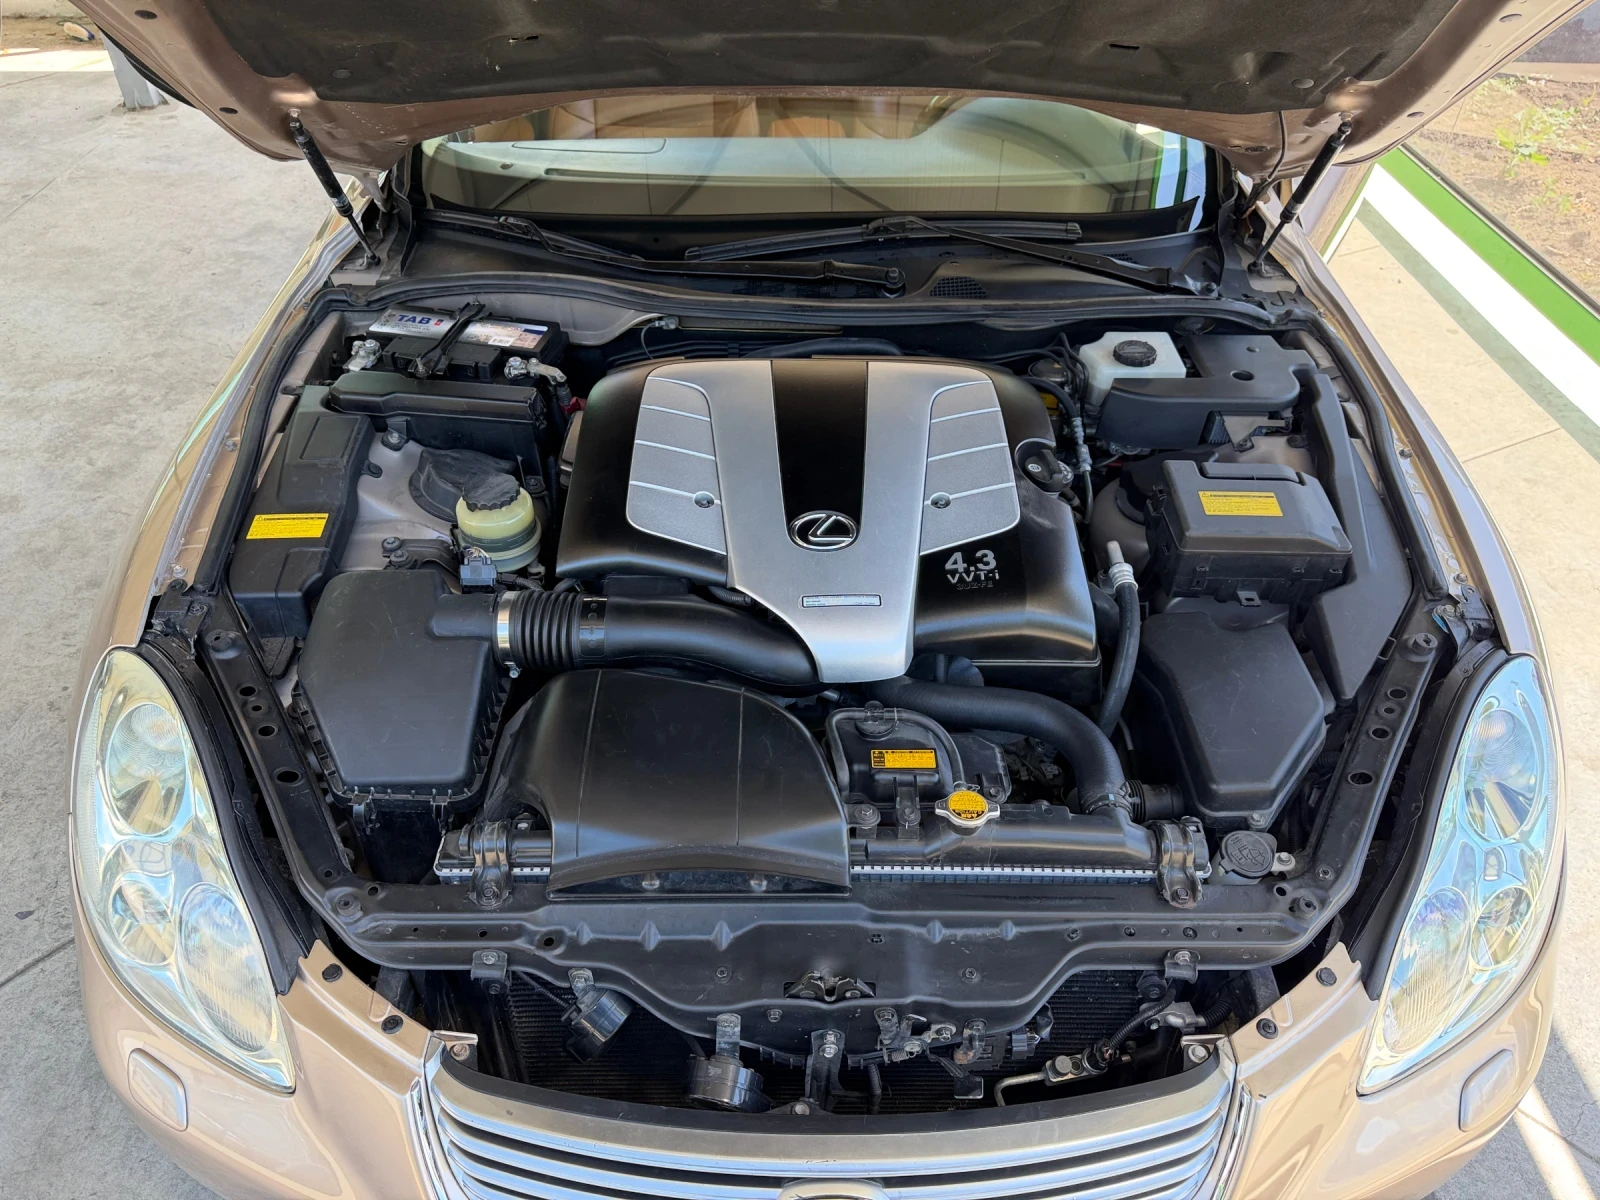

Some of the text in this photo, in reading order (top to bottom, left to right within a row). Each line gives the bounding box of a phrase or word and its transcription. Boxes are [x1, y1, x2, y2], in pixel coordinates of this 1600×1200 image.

[398, 314, 431, 324] TAB
[945, 550, 996, 572] 4.3
[947, 570, 999, 583] VVT-i
